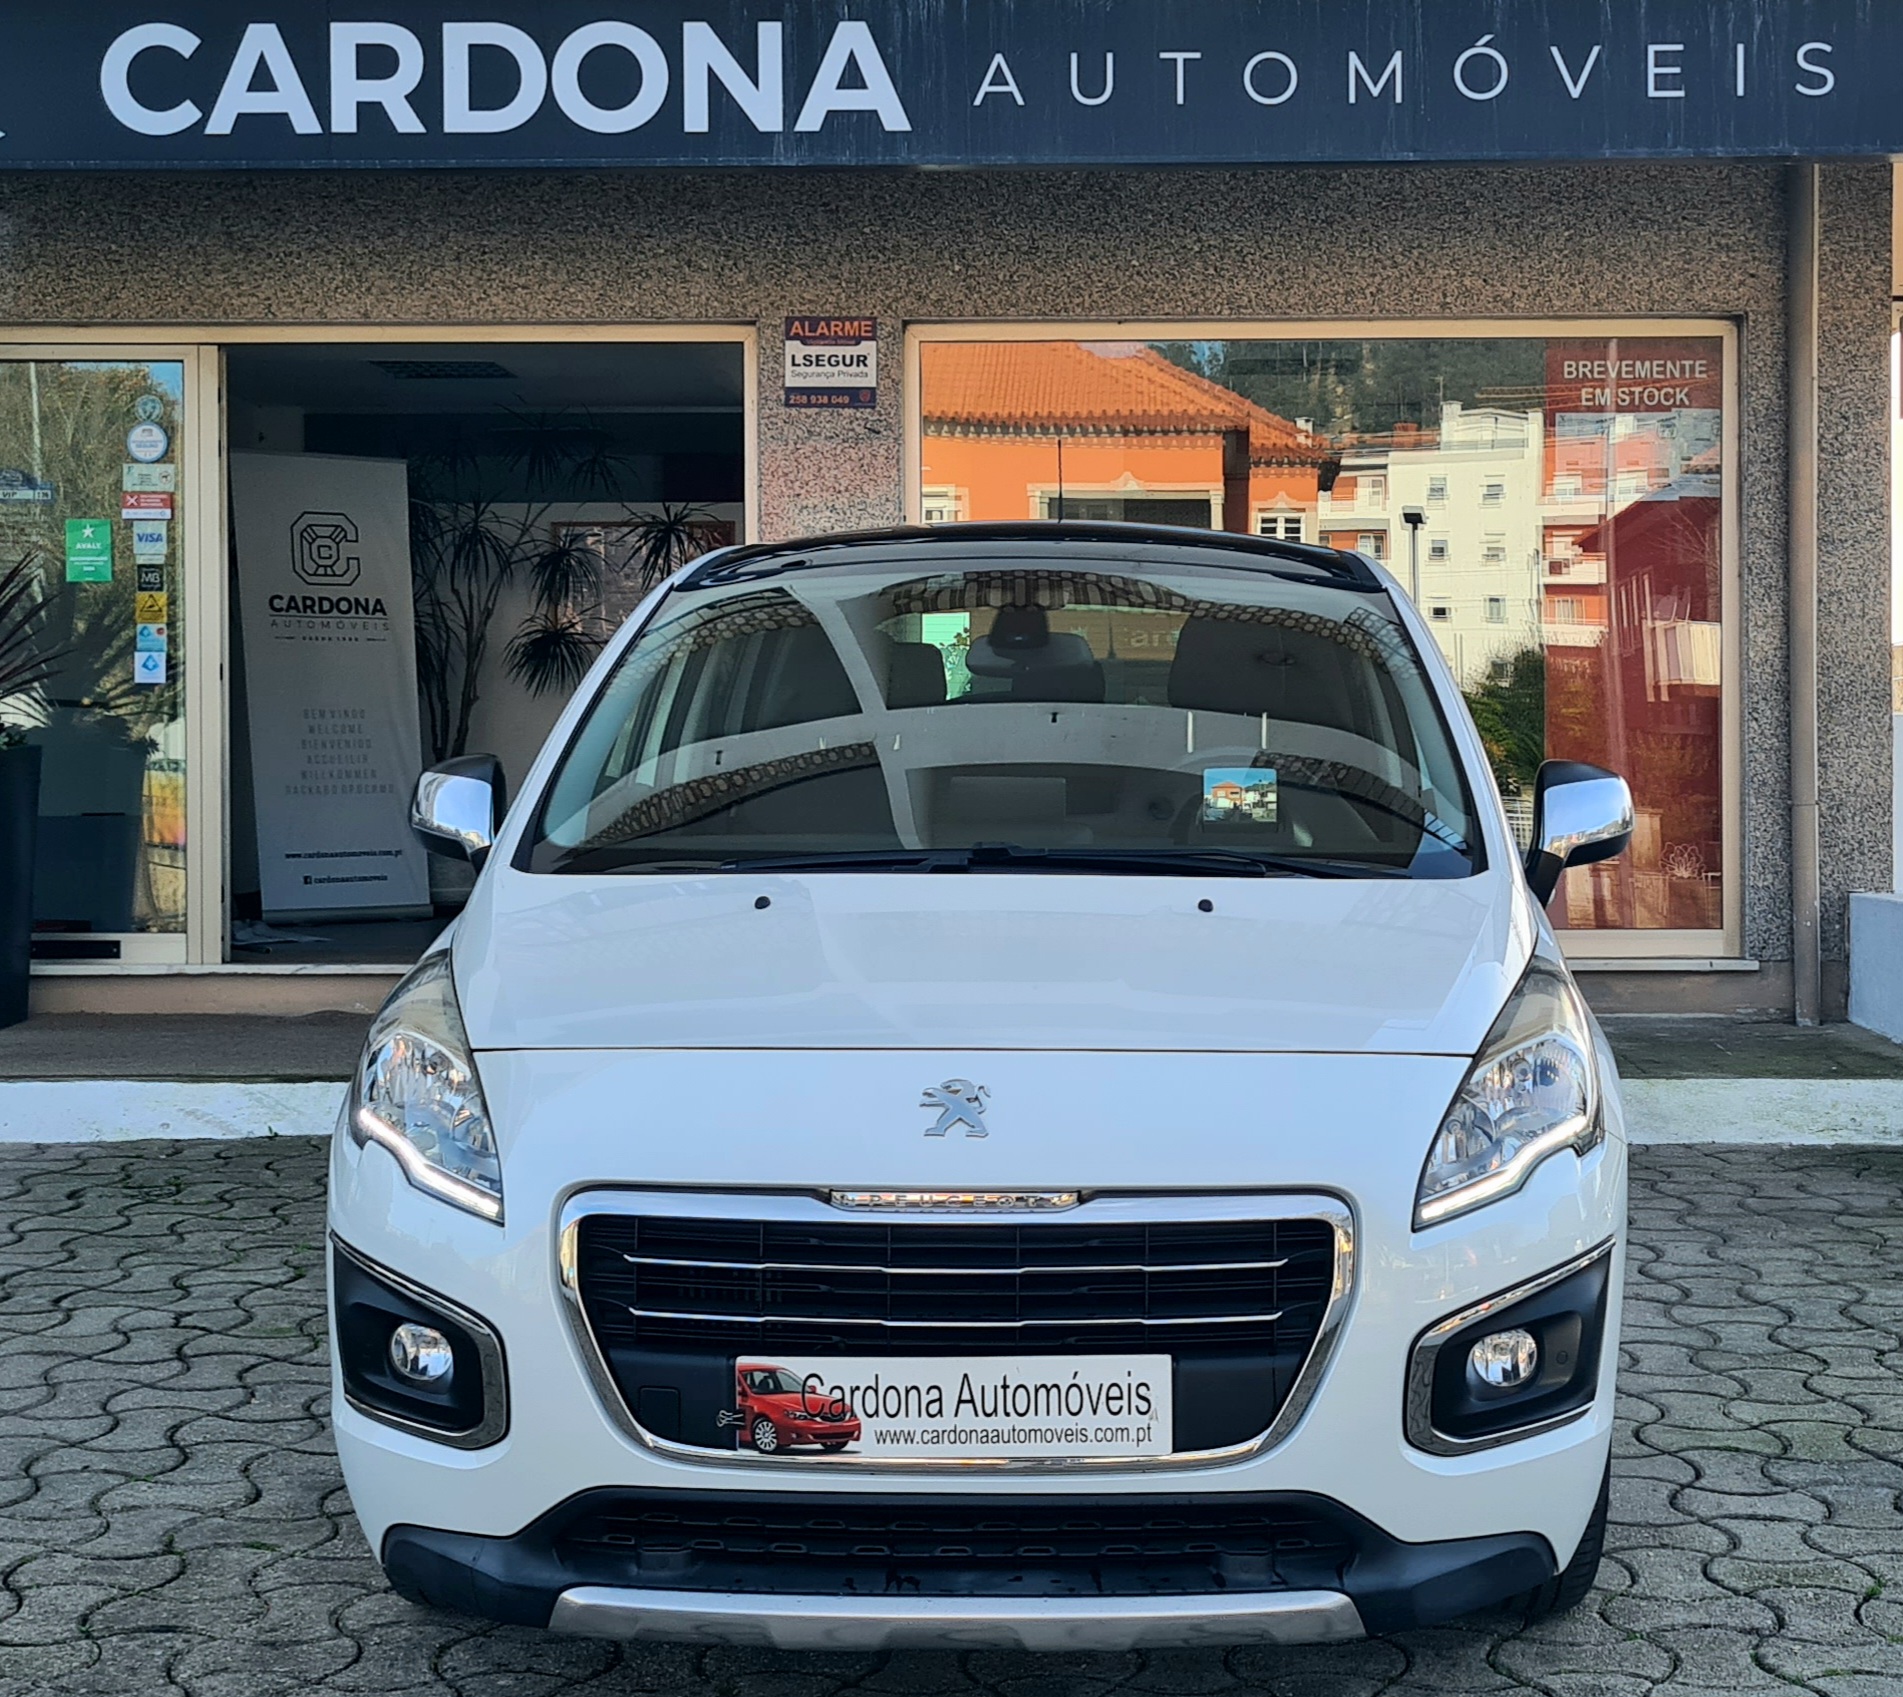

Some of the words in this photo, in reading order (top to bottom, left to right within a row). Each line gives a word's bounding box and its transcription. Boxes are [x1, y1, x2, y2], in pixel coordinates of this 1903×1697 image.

[100, 20, 912, 136] CARDONA
[973, 34, 1837, 106] AUTOMÓVEIS
[789, 320, 873, 337] ALARME
[790, 353, 869, 368] LSEGUR
[790, 370, 835, 380] Segurança
[837, 369, 869, 379] Privada
[1563, 360, 1708, 379] BREVEMENTE
[1580, 388, 1611, 406] EM
[1617, 387, 1690, 406] STOCK
[136, 532, 163, 543] VISA
[141, 572, 161, 583] MB
[268, 594, 387, 616] CARDONA
[308, 724, 364, 734] WELCOME
[869, 1194, 1041, 1208] PEUGEOT
[801, 1372, 944, 1419] Cardona
[954, 1370, 1152, 1418] Automóveis
[873, 1422, 1153, 1446] www.cardonaautomoveis.com.pt
